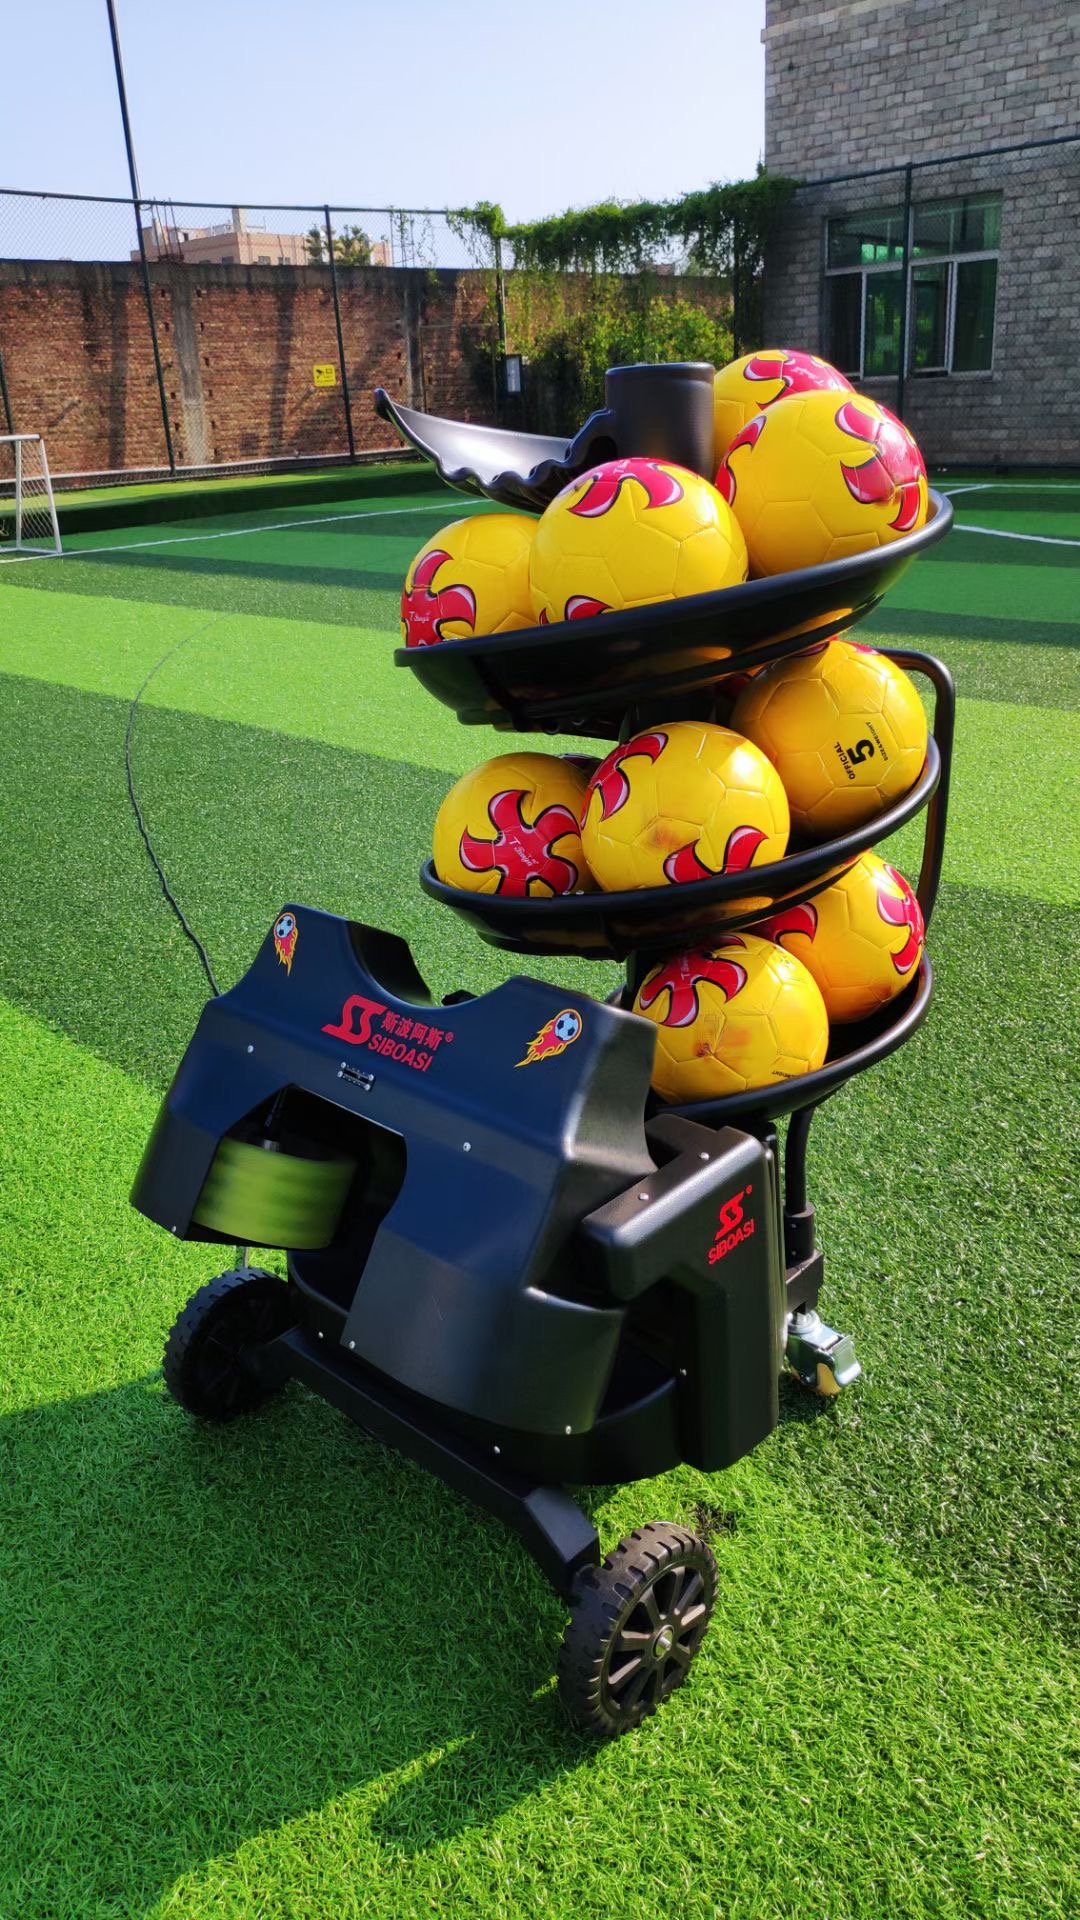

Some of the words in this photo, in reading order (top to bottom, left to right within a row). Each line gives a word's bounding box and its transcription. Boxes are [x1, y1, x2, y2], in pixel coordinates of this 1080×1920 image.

[834, 741, 856, 780] OFFICIAL
[846, 739, 875, 766] 5
[381, 1010, 444, 1051] 斯波阿斯
[368, 1033, 434, 1072] SIBOASI
[708, 1217, 755, 1265] SIBOASI
